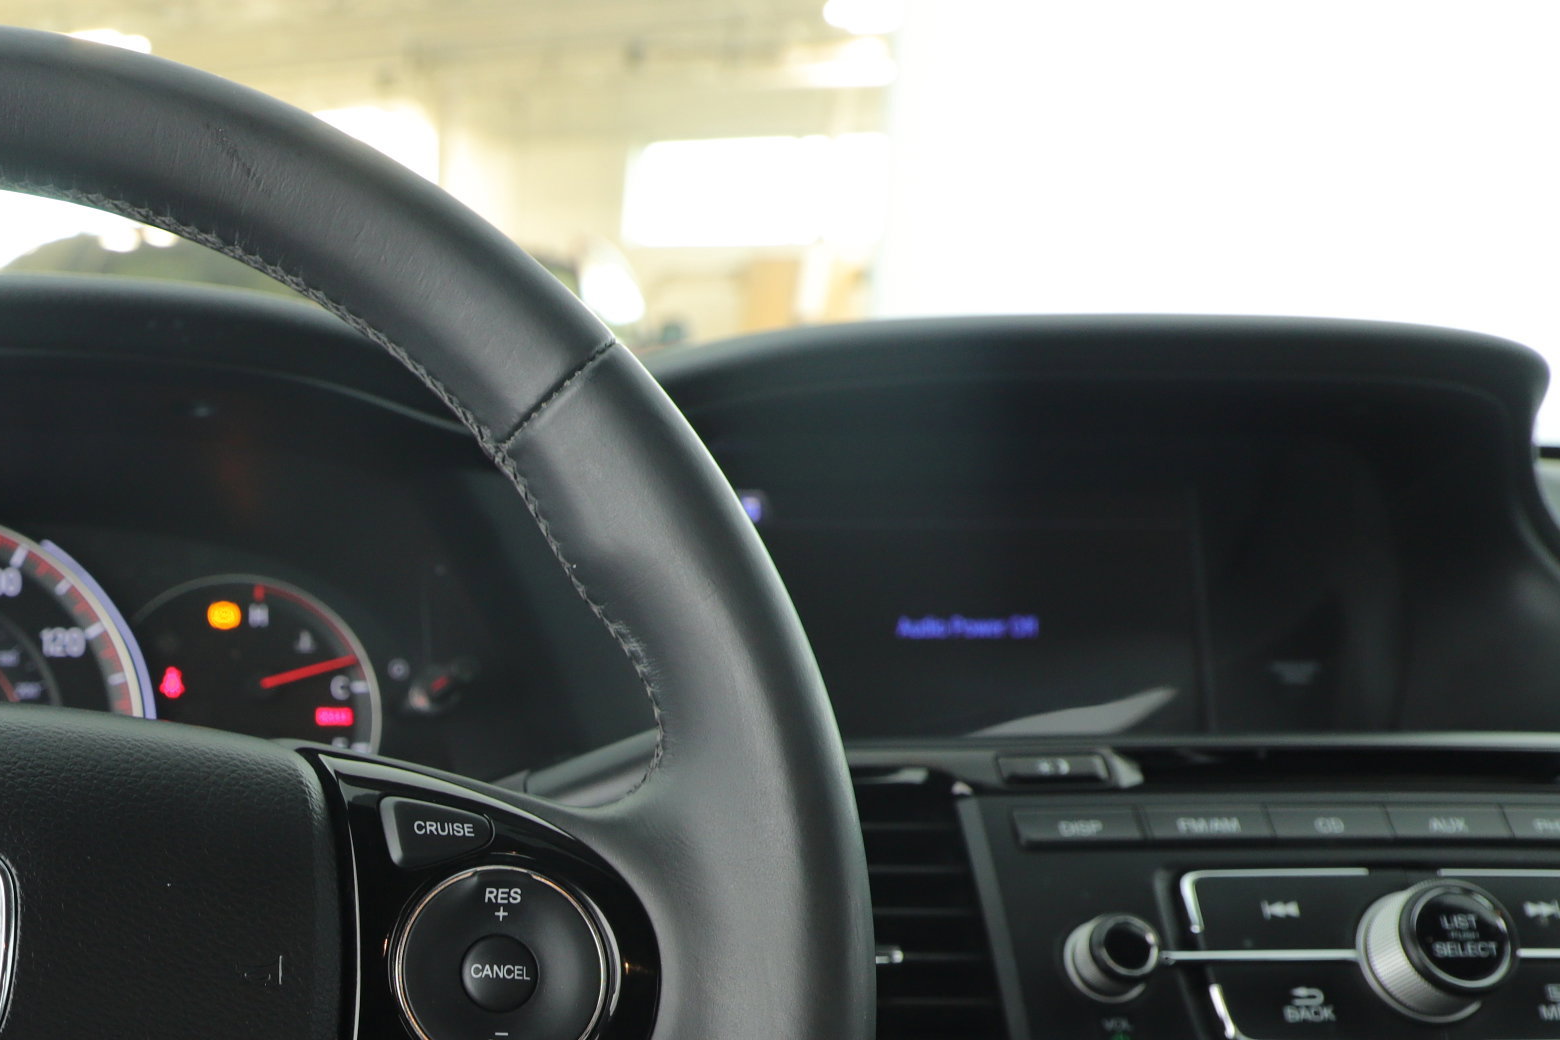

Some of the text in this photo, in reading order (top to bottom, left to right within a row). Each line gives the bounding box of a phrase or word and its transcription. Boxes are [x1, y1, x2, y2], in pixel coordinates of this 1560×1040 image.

[40, 627, 87, 658] 120
[413, 820, 476, 837] CRUISE
[1057, 819, 1103, 837] DISP
[1313, 817, 1345, 834] CD
[1428, 816, 1469, 833] AUX
[484, 887, 522, 905] RES
[1440, 913, 1478, 931] LIST
[1432, 940, 1498, 958] SELECT
[470, 963, 531, 981] CANCEL
[1283, 1004, 1337, 1023] BACK
